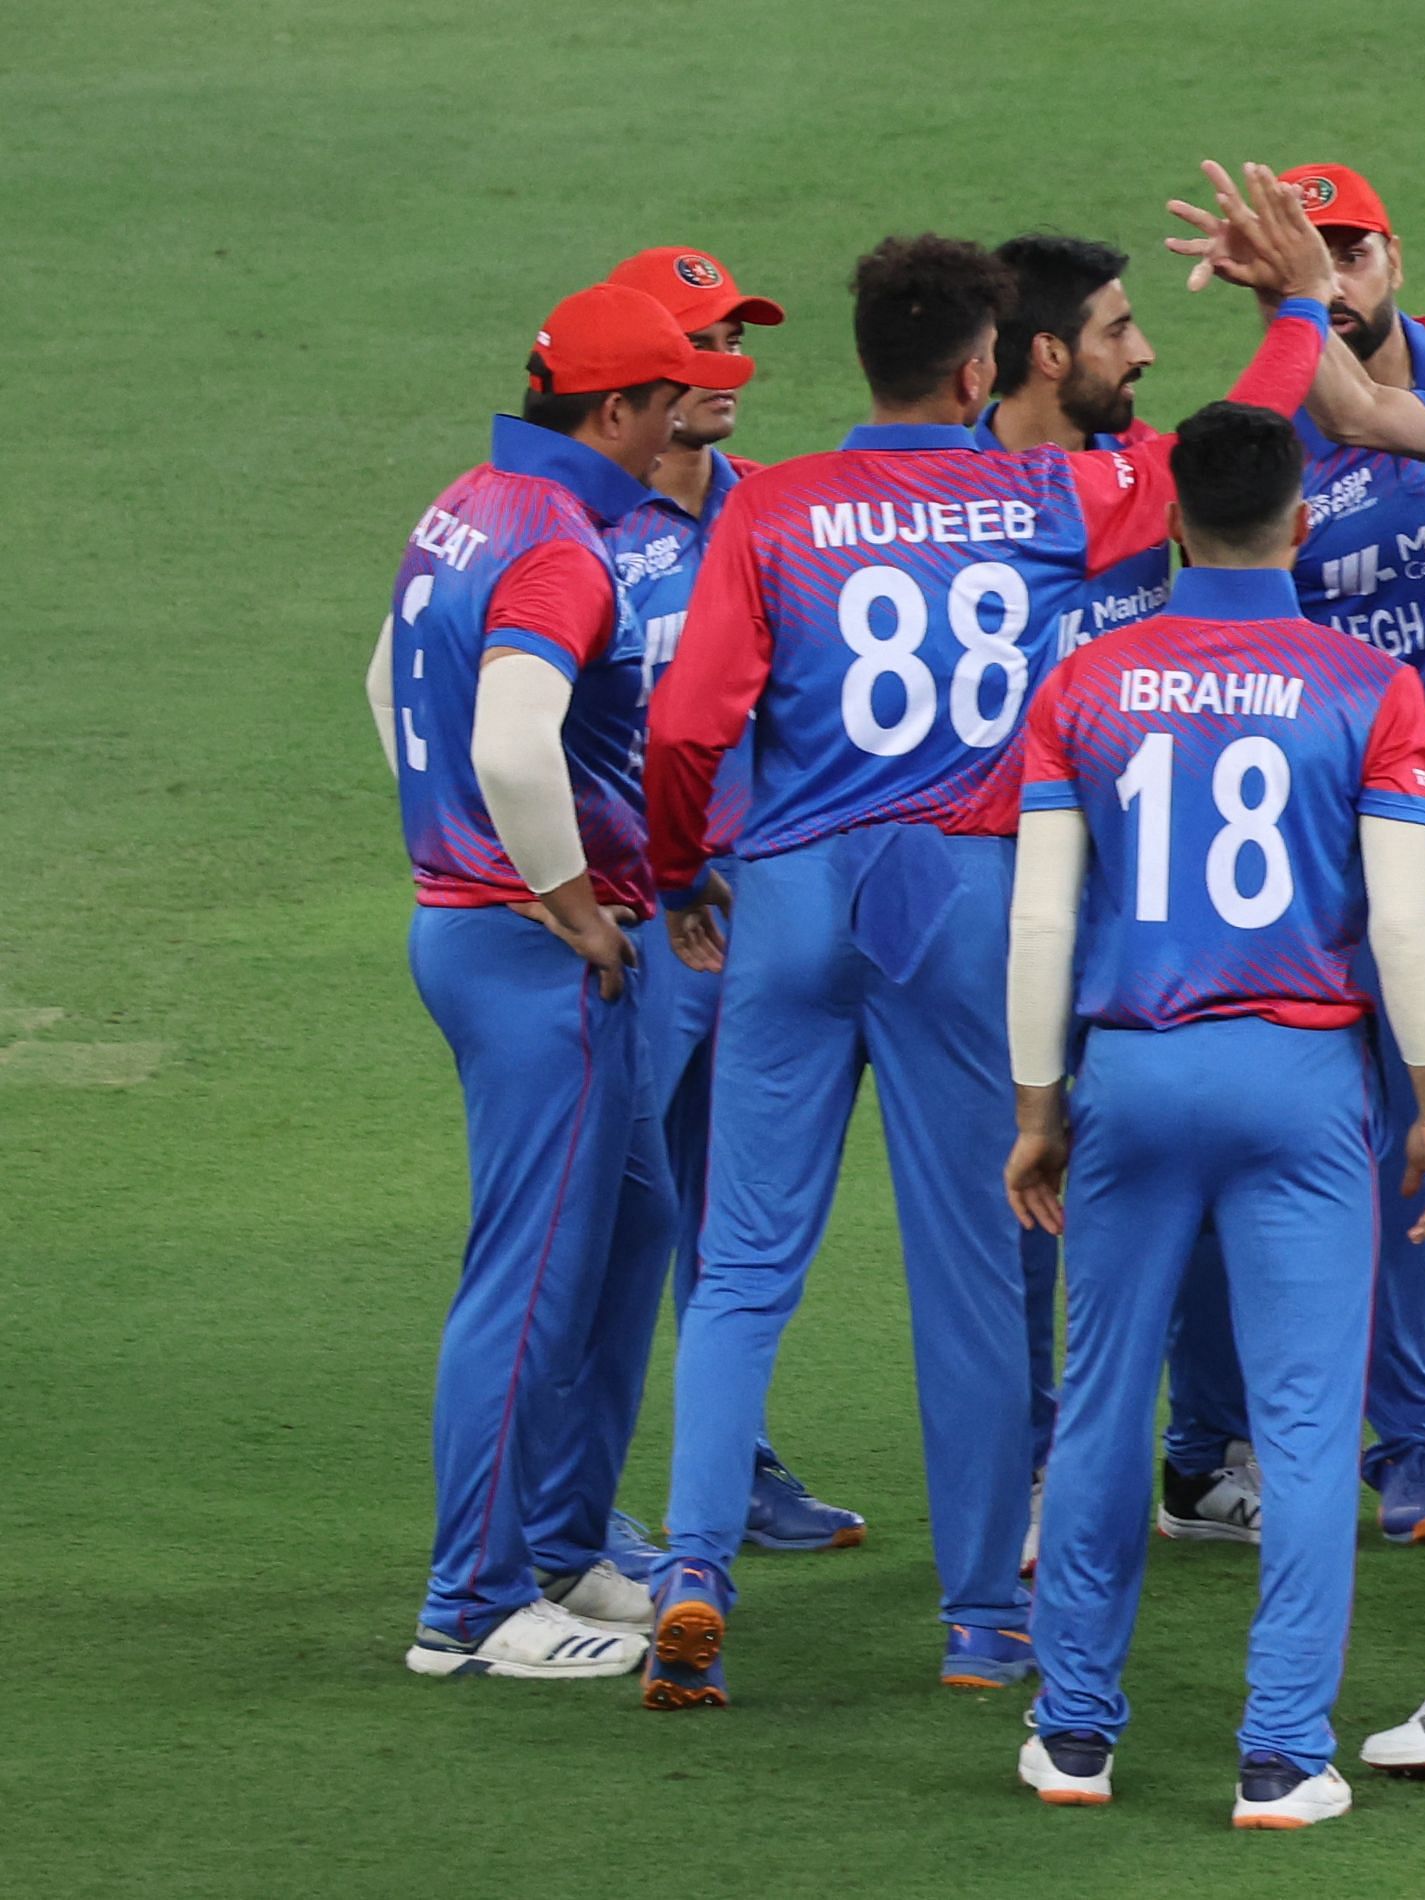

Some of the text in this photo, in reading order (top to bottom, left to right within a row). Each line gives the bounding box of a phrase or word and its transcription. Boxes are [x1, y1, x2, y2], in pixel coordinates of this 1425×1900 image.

[809, 499, 1036, 549] MUJEEB
[837, 561, 1030, 757] 88
[1119, 668, 1304, 720] IBRAHIM
[1115, 732, 1294, 930] 18
